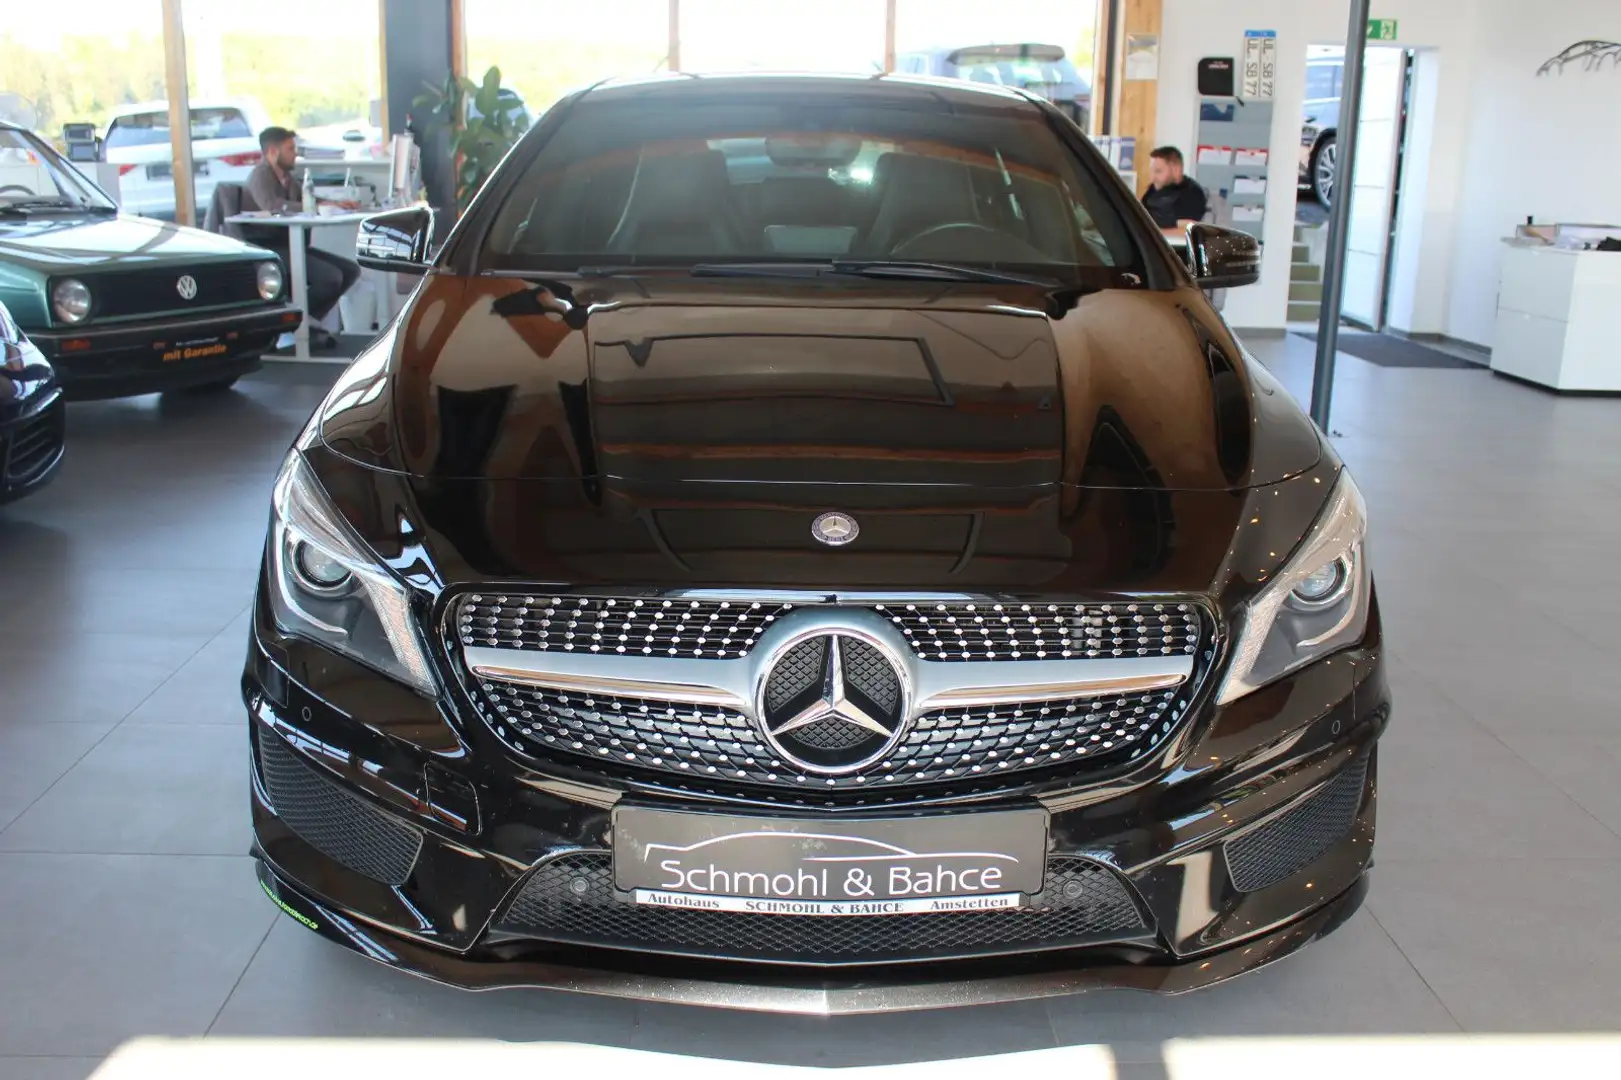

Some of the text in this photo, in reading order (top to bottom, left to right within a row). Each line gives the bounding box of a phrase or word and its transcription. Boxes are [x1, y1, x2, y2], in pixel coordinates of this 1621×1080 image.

[1246, 38, 1258, 54] UL
[1263, 38, 1274, 54] UL
[1244, 81, 1258, 96] 77
[1262, 81, 1273, 97] 77
[660, 860, 1002, 897] Schmohl & Bahce
[649, 893, 1009, 915] Autohaus SCHMOHL & BAHCE Amstetten
